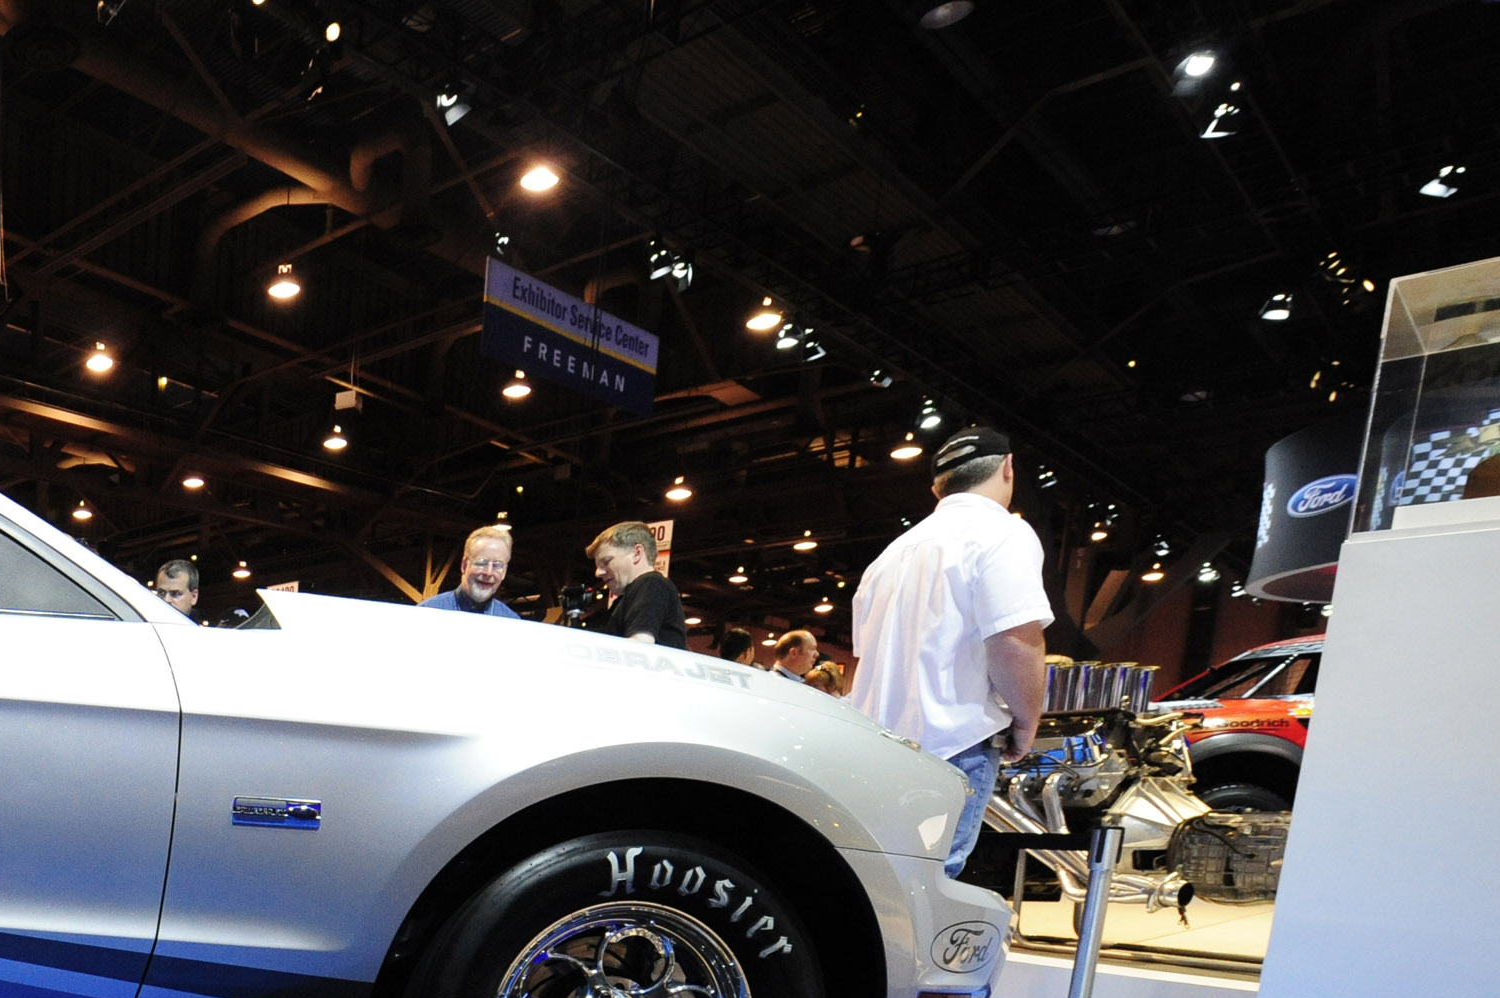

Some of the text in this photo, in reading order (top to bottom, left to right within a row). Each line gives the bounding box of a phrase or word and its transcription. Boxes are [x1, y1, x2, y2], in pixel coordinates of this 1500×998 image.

[512, 276, 649, 358] Exhibitor Service Center
[523, 335, 626, 392] FREEMAN
[1297, 481, 1349, 513] Ford
[684, 662, 752, 689] JET
[600, 846, 792, 959] Hoosier
[942, 928, 993, 965] Ford
